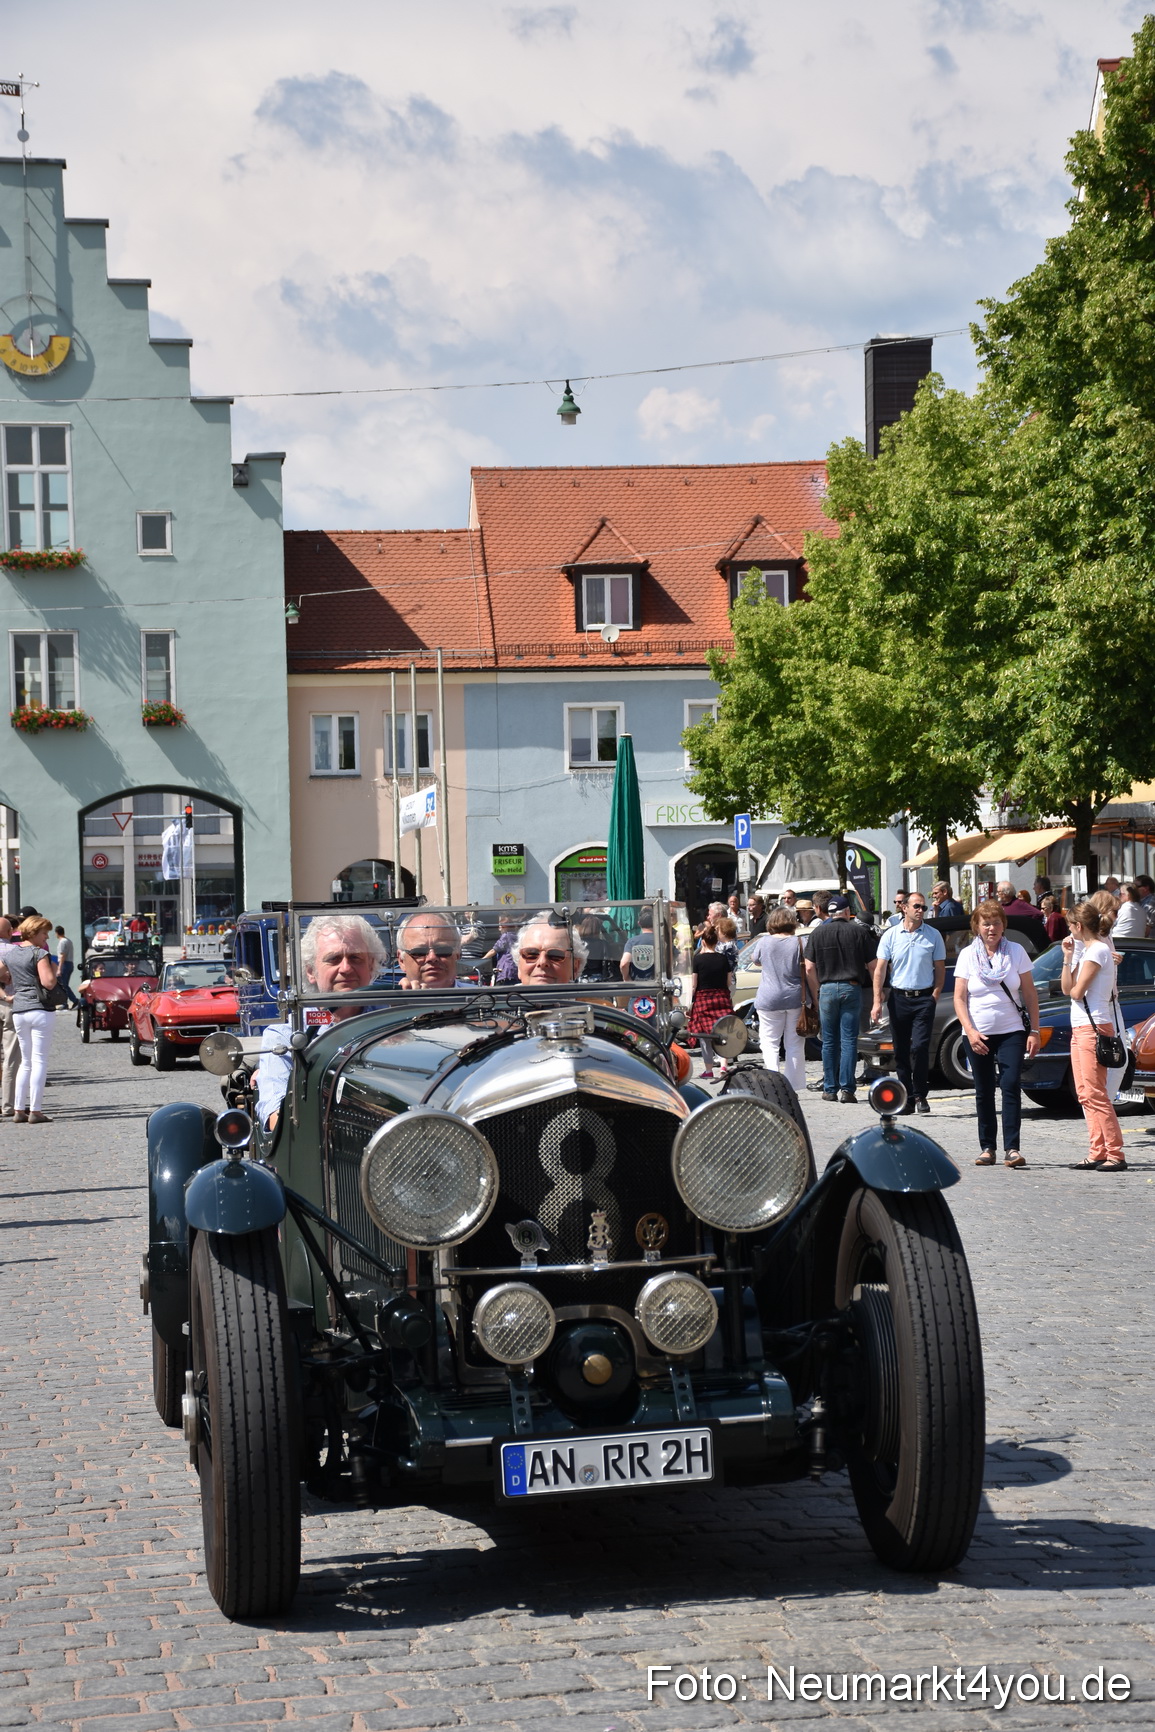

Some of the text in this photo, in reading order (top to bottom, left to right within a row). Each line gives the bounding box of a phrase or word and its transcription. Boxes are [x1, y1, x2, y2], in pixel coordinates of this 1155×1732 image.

[20, 362, 28, 372] 10
[30, 364, 39, 373] 12
[738, 819, 748, 846] P
[511, 1436, 709, 1488] D AN RR 2H
